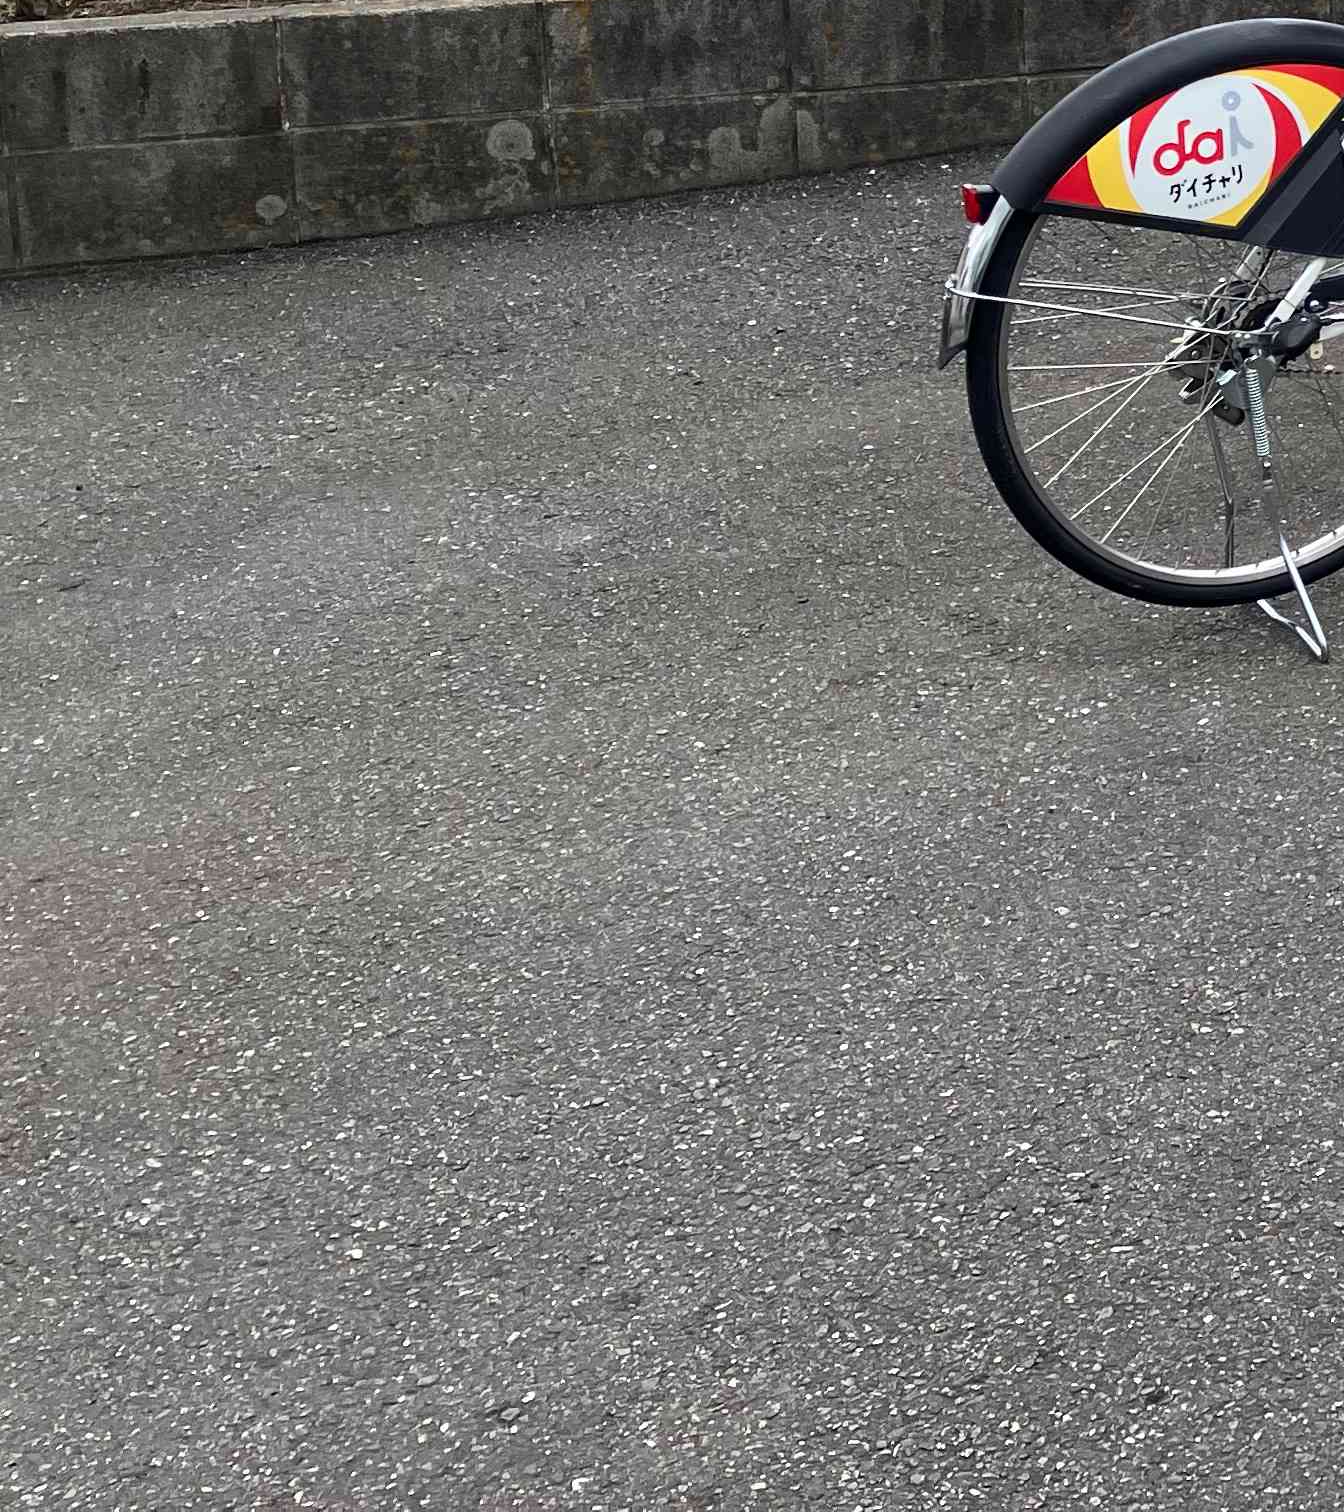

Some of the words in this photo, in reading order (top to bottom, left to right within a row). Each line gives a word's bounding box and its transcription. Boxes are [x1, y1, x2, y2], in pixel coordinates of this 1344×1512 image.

[1152, 90, 1254, 176] dai
[1169, 164, 1243, 203] ダイチャリ
